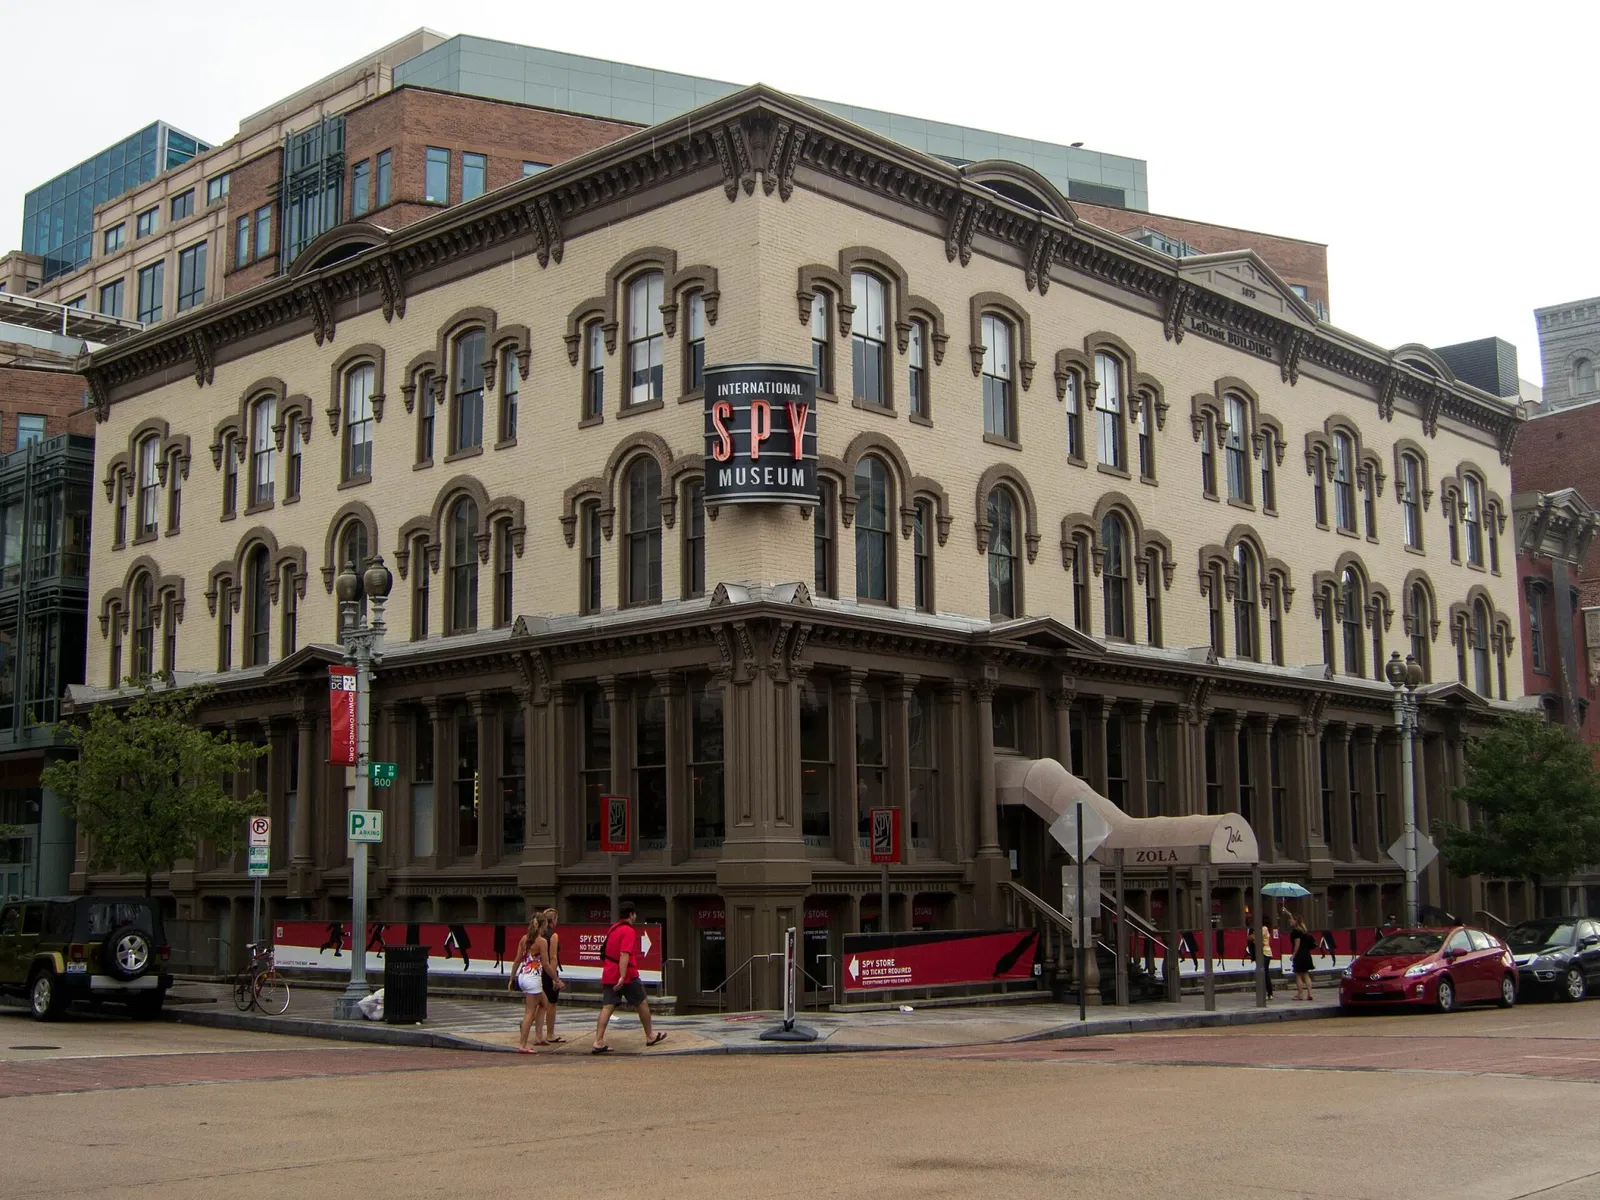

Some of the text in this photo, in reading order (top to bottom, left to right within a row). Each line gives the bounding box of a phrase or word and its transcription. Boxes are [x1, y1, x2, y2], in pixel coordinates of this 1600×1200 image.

[1191, 317, 1272, 358] LeDroit BUILDING
[717, 381, 803, 396] INTERNATIONAL
[712, 399, 810, 462] SPY
[719, 466, 805, 487] MUSEUM
[331, 682, 342, 690] DC
[374, 765, 382, 776] F
[374, 778, 391, 787] 800
[875, 814, 891, 837] SPY
[1136, 850, 1178, 862] ZOLA
[698, 911, 725, 919] SPY STO
[808, 910, 829, 918] STORE
[580, 935, 592, 943] SPY
[862, 959, 896, 968] SPY STORE
